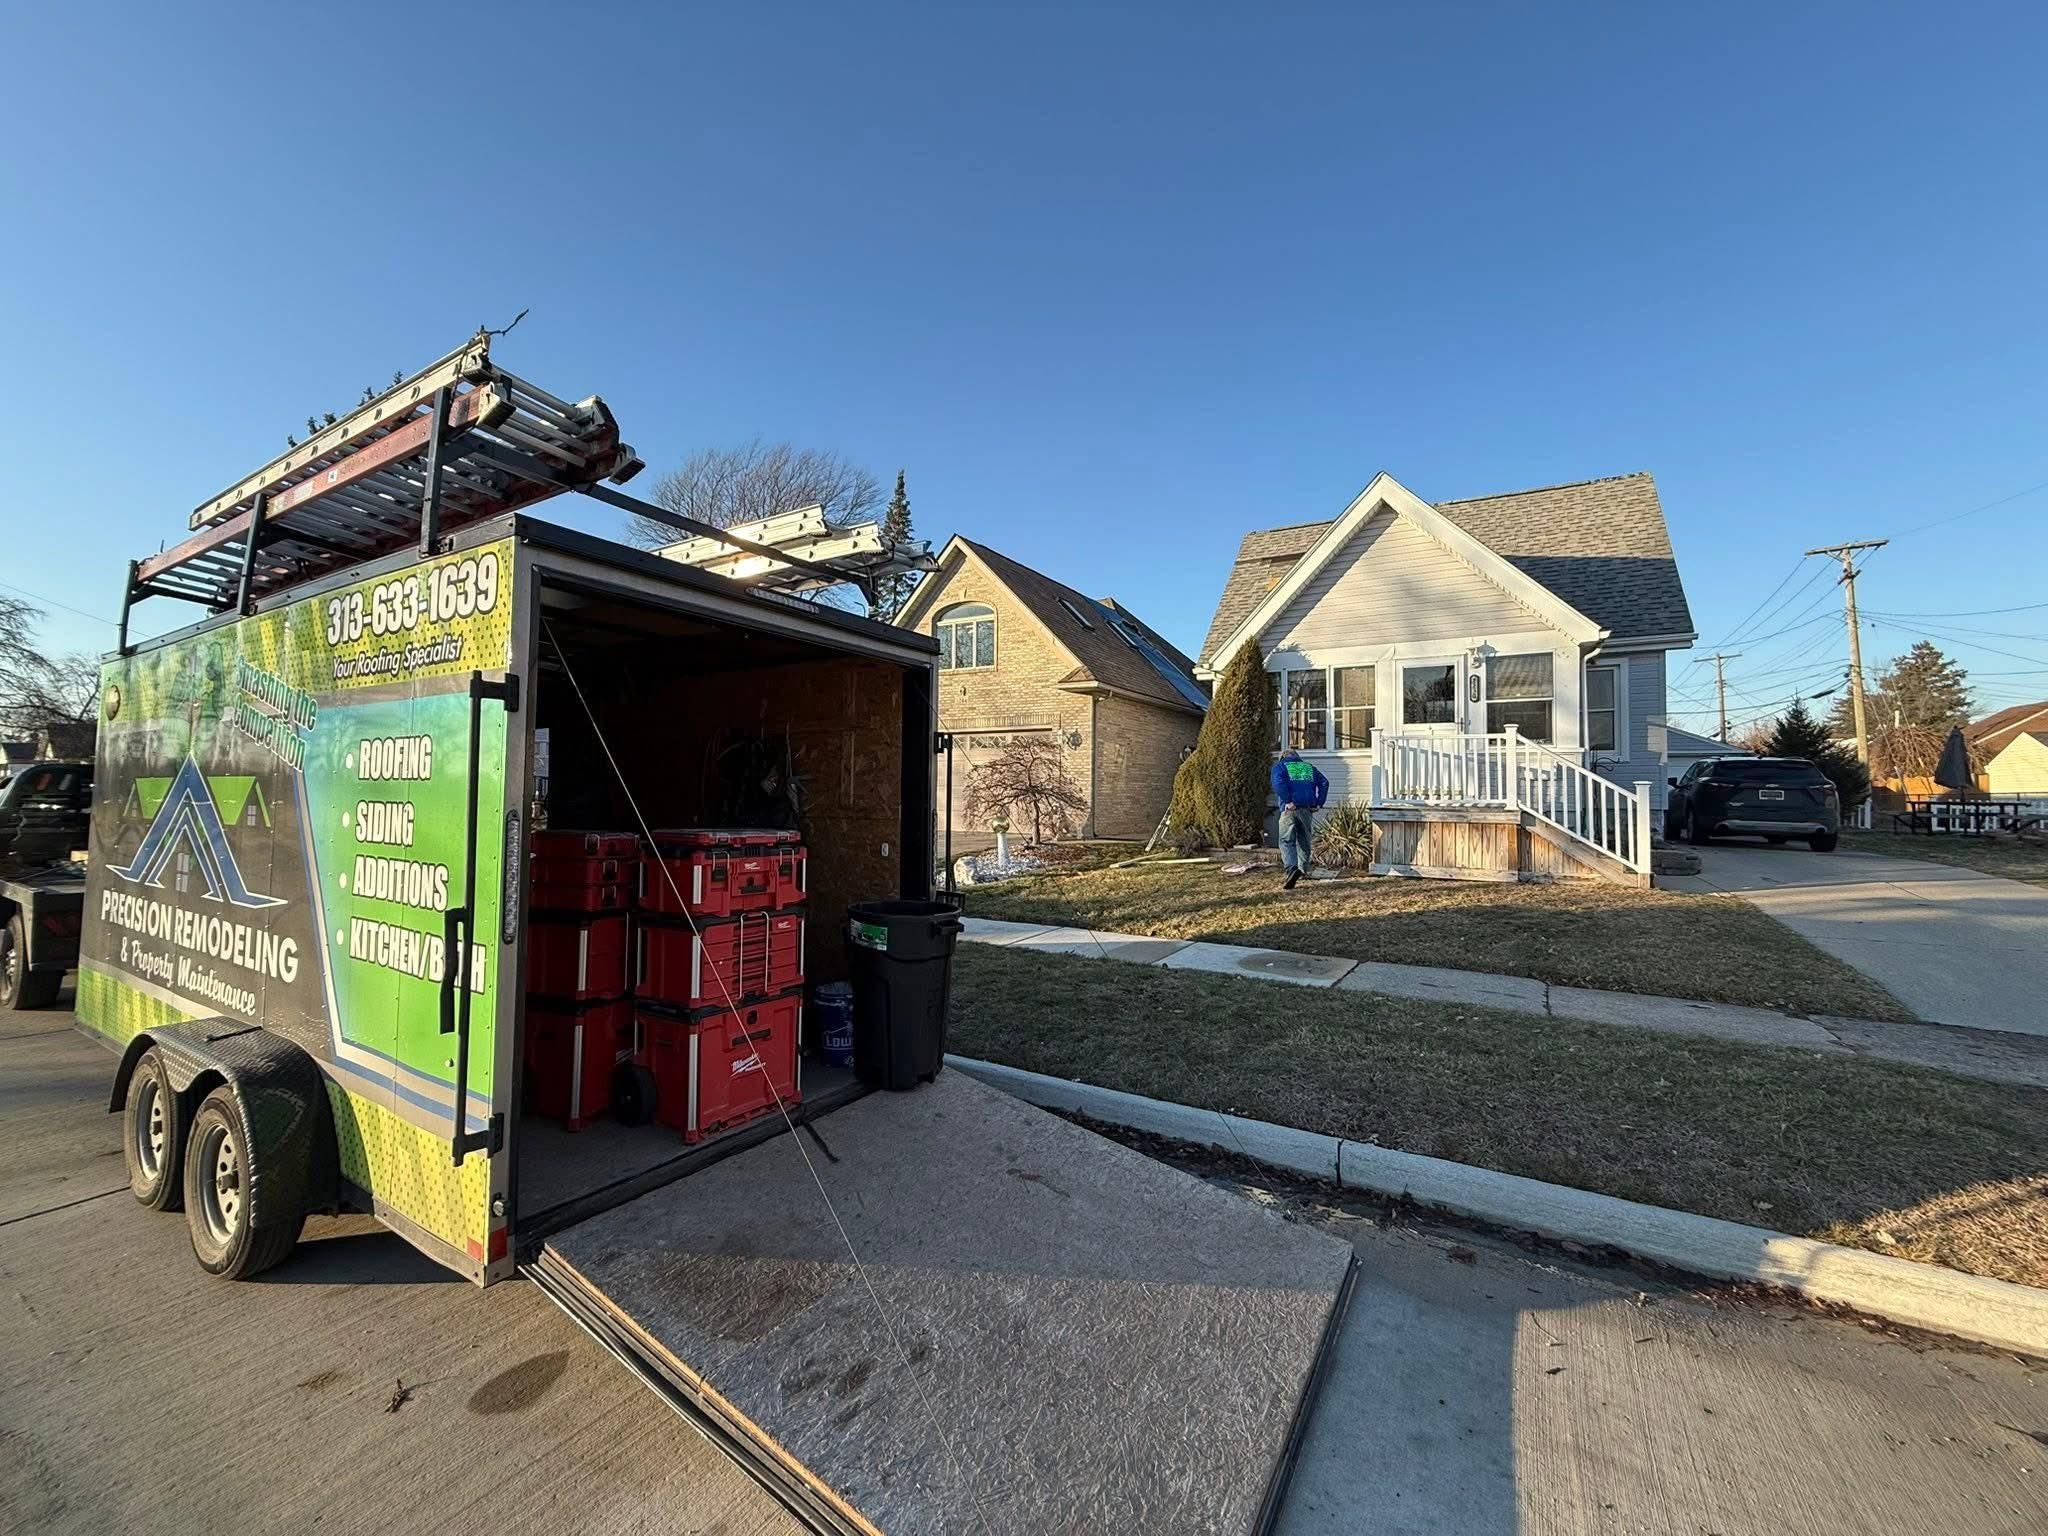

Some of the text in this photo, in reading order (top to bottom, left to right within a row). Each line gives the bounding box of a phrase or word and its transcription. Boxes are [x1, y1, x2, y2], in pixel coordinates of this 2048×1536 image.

[327, 552, 498, 646] 313-633-1639
[332, 633, 463, 680] Your Roofing Specialist
[293, 687, 318, 732] the
[358, 734, 433, 782] ROOFING
[355, 800, 415, 848] SIDING
[352, 854, 449, 912] ADDITIONS
[101, 890, 298, 983] PRECISION REMODELING
[350, 916, 487, 995] KITCHEN/BTH
[119, 936, 257, 1017] & Property Maintenance
